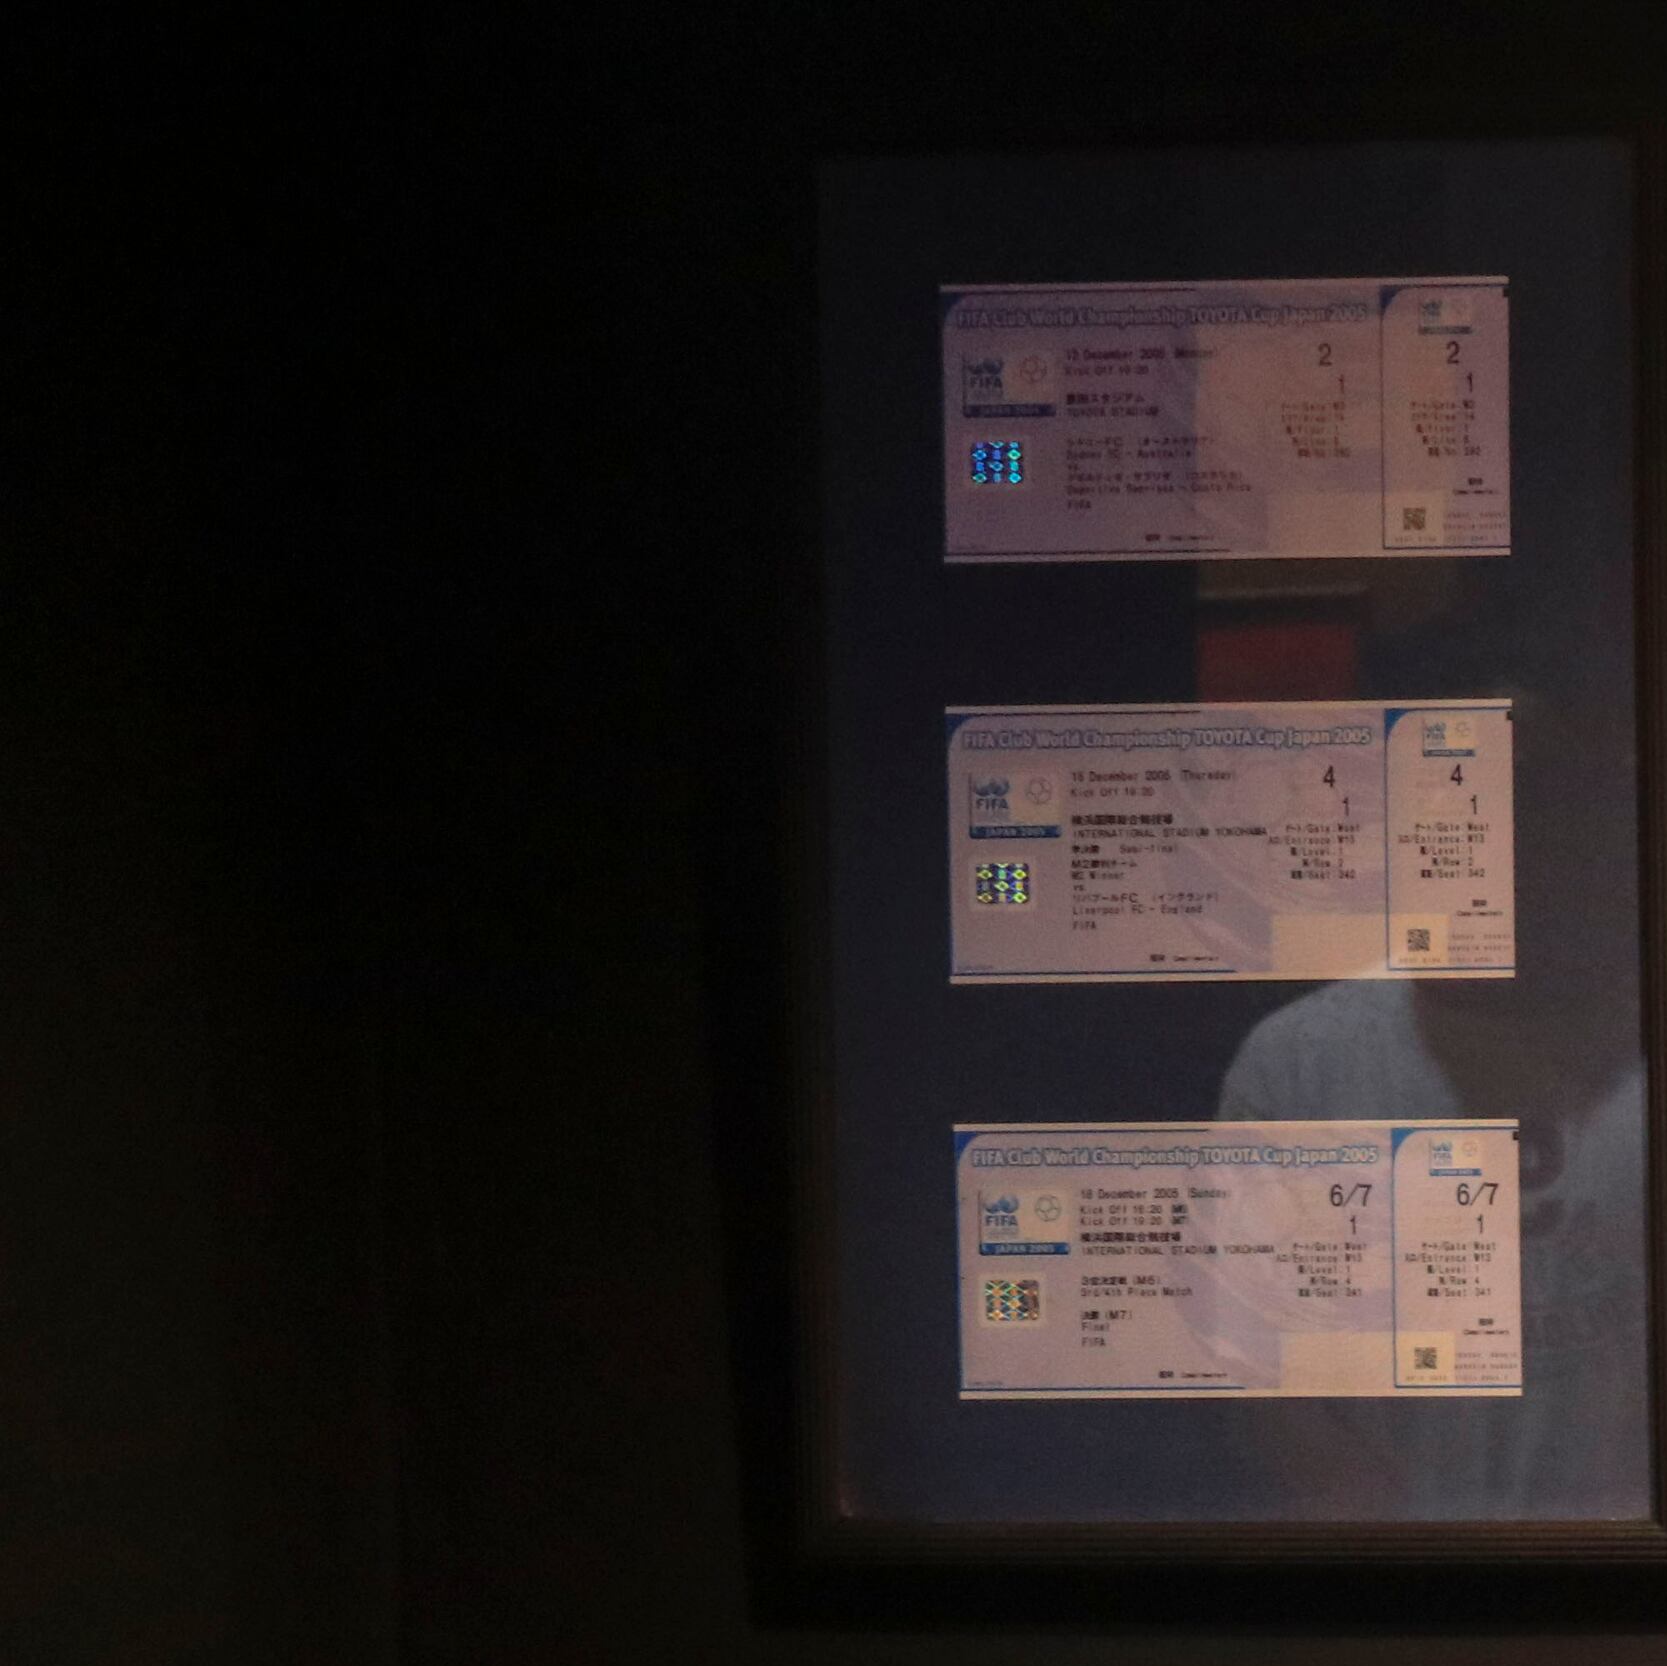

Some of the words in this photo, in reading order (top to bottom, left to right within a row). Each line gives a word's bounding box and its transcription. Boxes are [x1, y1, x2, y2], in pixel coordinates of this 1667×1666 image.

[957, 309, 989, 326] FIFA
[993, 309, 1026, 326] Club
[1029, 308, 1074, 326] World
[1077, 307, 1187, 328] Championship
[1189, 306, 1248, 323] TOYOTA
[1251, 305, 1279, 326] Cup
[1284, 305, 1326, 326] Japan
[1328, 303, 1368, 322] 2005
[1318, 343, 1332, 366] 2
[1446, 341, 1460, 364] 2
[1338, 374, 1345, 393] 1
[1467, 372, 1473, 392] 1
[963, 731, 995, 748] FIFA
[999, 730, 1032, 748] Club
[1035, 730, 1080, 748] World
[1083, 729, 1191, 751] Championship
[1194, 728, 1252, 746] TOYOTA
[1255, 729, 1283, 749] Cup
[1287, 728, 1331, 749] Japan
[1334, 726, 1372, 745] 2005
[1322, 765, 1336, 787] 4
[1450, 763, 1463, 786] 4
[975, 798, 1009, 810] FIFA
[1342, 796, 1349, 816] 1
[1470, 794, 1477, 814] 1
[972, 1149, 1004, 1166] FIFA
[1007, 1148, 1041, 1166] Club
[1045, 1148, 1089, 1166] World
[1092, 1148, 1200, 1169] Championship
[1203, 1146, 1262, 1164] TOYOTA
[1263, 1147, 1292, 1168] Cup
[1296, 1146, 1339, 1167] Japan
[1341, 1145, 1379, 1164] 2005
[1329, 1182, 1373, 1207] 6/7
[1456, 1181, 1499, 1207] 6/7
[985, 1215, 1019, 1227] FIFA
[1350, 1214, 1357, 1235] 1
[1476, 1213, 1484, 1234] 1
